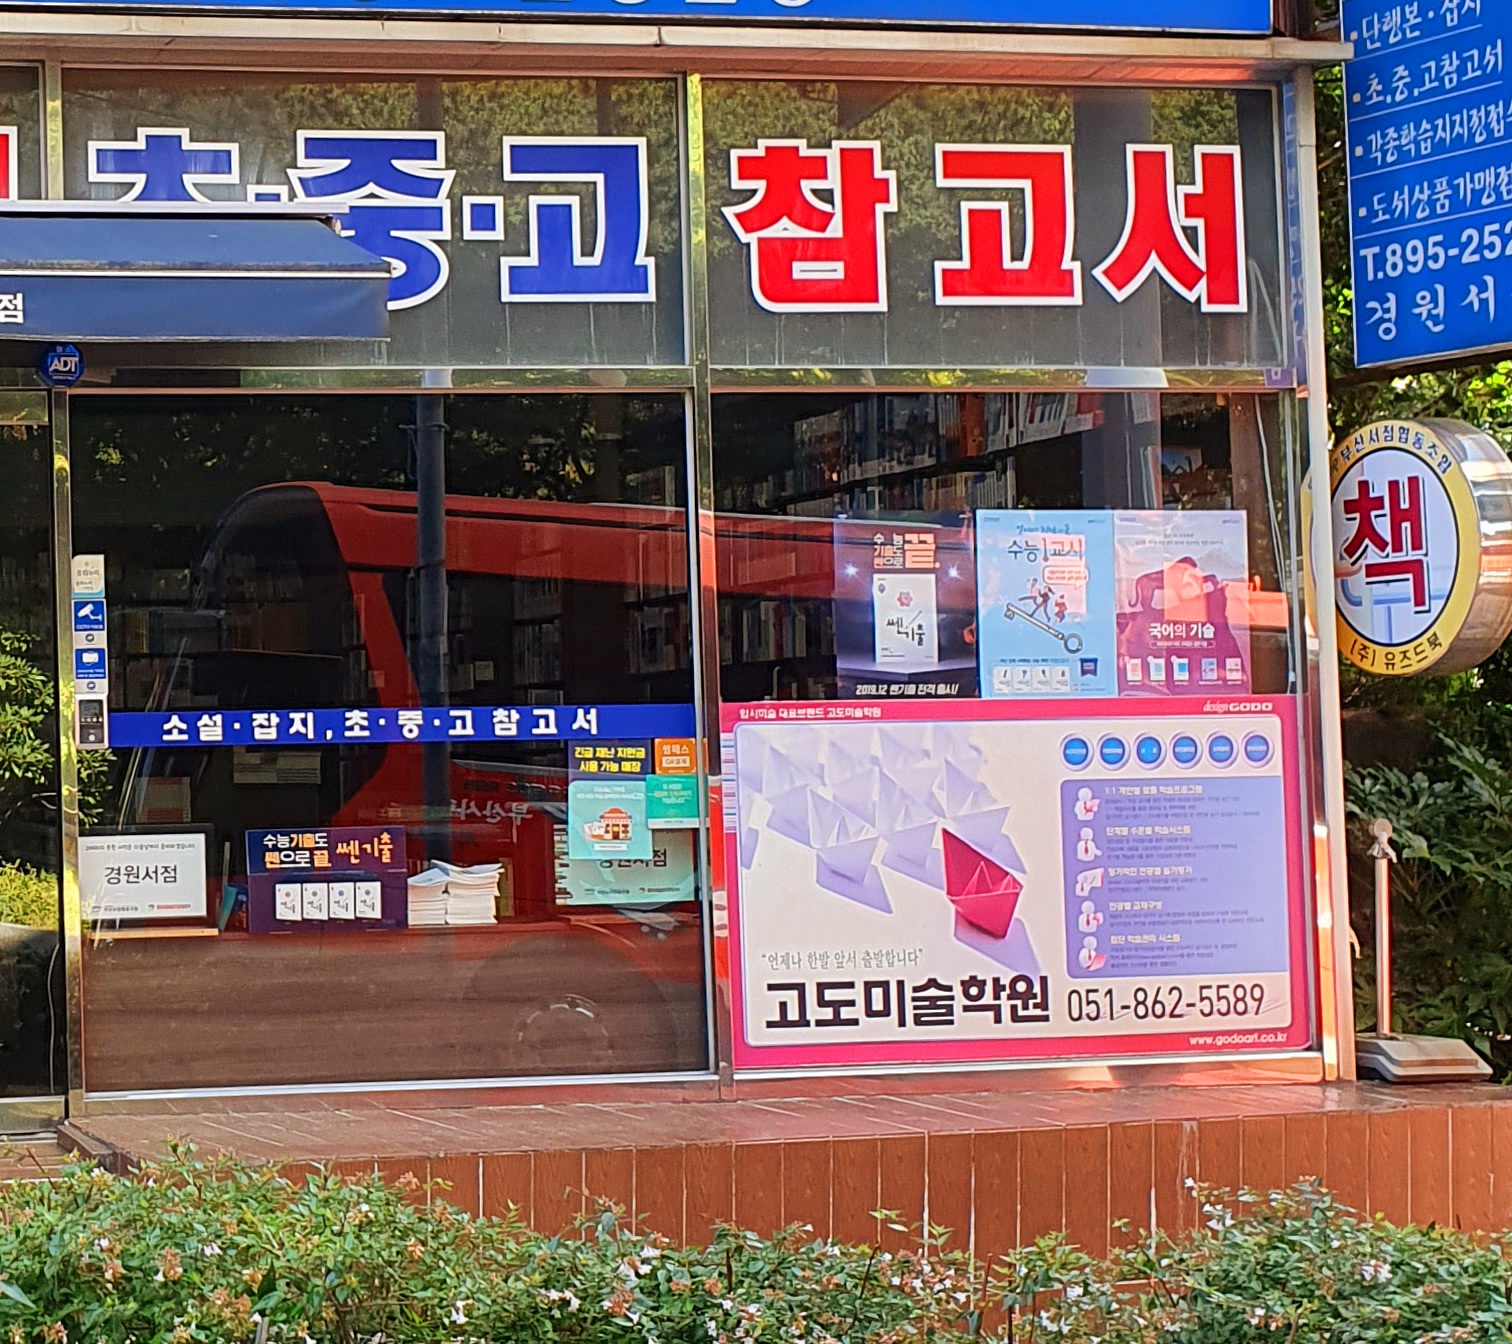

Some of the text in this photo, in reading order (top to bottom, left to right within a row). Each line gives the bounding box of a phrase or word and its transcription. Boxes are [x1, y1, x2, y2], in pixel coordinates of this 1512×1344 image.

[720, 138, 1248, 314] 참고서
[48, 356, 79, 373] ADT
[1343, 475, 1431, 614] 책
[104, 864, 178, 885] 경원서점
[765, 973, 1051, 1030] 고도미술학원
[1067, 982, 1265, 1023] 051-862-5589
